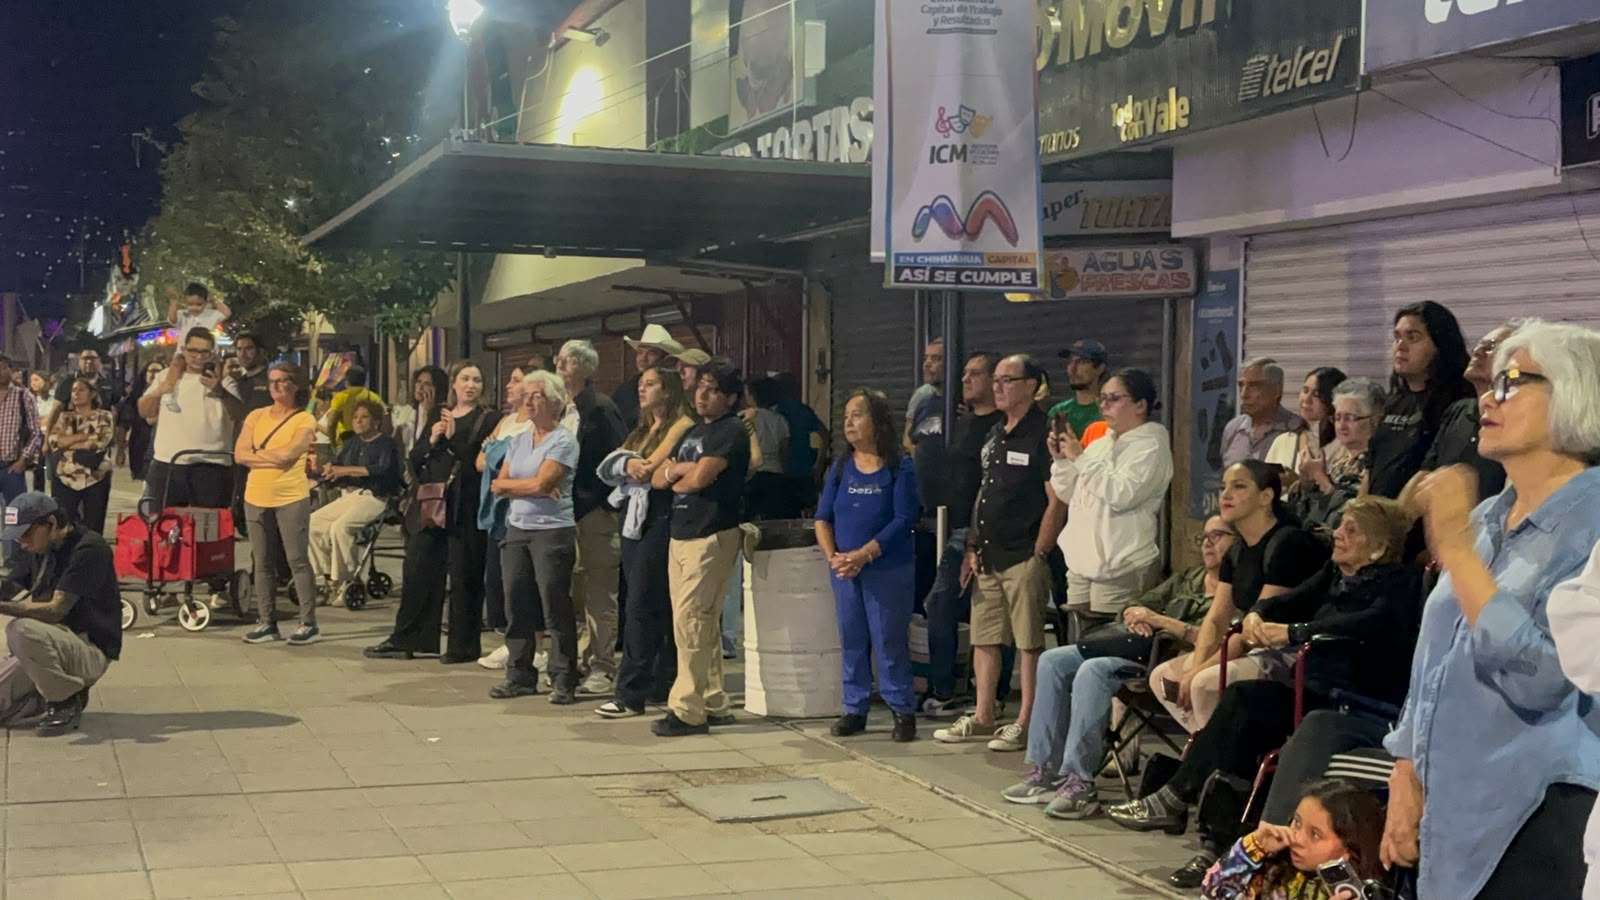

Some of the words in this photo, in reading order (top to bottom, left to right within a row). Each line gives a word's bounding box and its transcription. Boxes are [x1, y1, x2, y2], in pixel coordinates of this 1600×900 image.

[1263, 35, 1343, 97] telcel
[929, 144, 967, 164] ICM
[900, 255, 914, 263] EN
[917, 255, 982, 264] CHIHUAHUA
[987, 255, 1031, 264] CAPITAL
[1083, 249, 1184, 272] AGUAS
[900, 266, 929, 282] ASÍ
[934, 270, 956, 282] SE
[960, 271, 1032, 284] CUMPLE
[1080, 271, 1191, 292] FRESCAS
